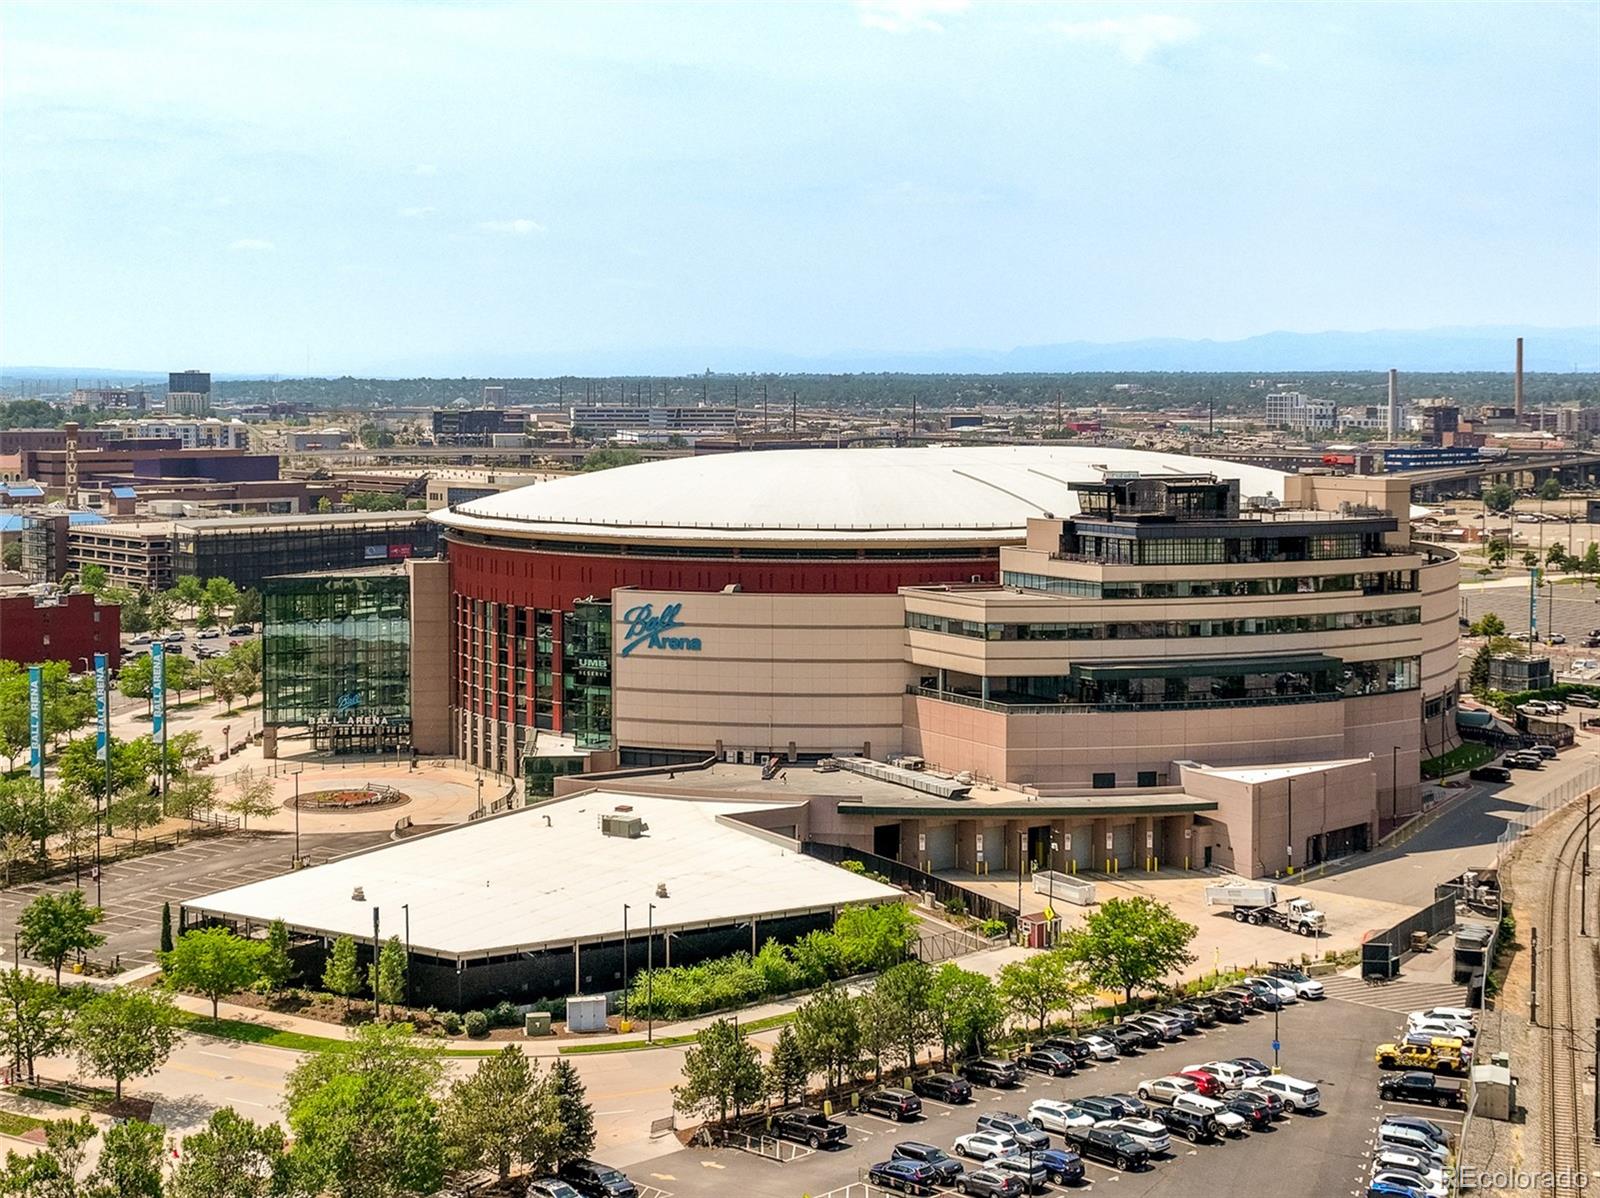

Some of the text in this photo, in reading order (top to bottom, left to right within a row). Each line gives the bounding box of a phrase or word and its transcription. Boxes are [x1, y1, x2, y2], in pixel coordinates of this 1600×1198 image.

[67, 440, 77, 506] TIVOLI
[622, 603, 685, 658] Ball
[648, 634, 702, 651] Arena
[96, 666, 105, 705] ARENA
[153, 654, 163, 717] BALL ARENA
[579, 658, 607, 667] UMB
[30, 680, 40, 749] BALL ARENA
[308, 716, 388, 725] BALL ARENA
